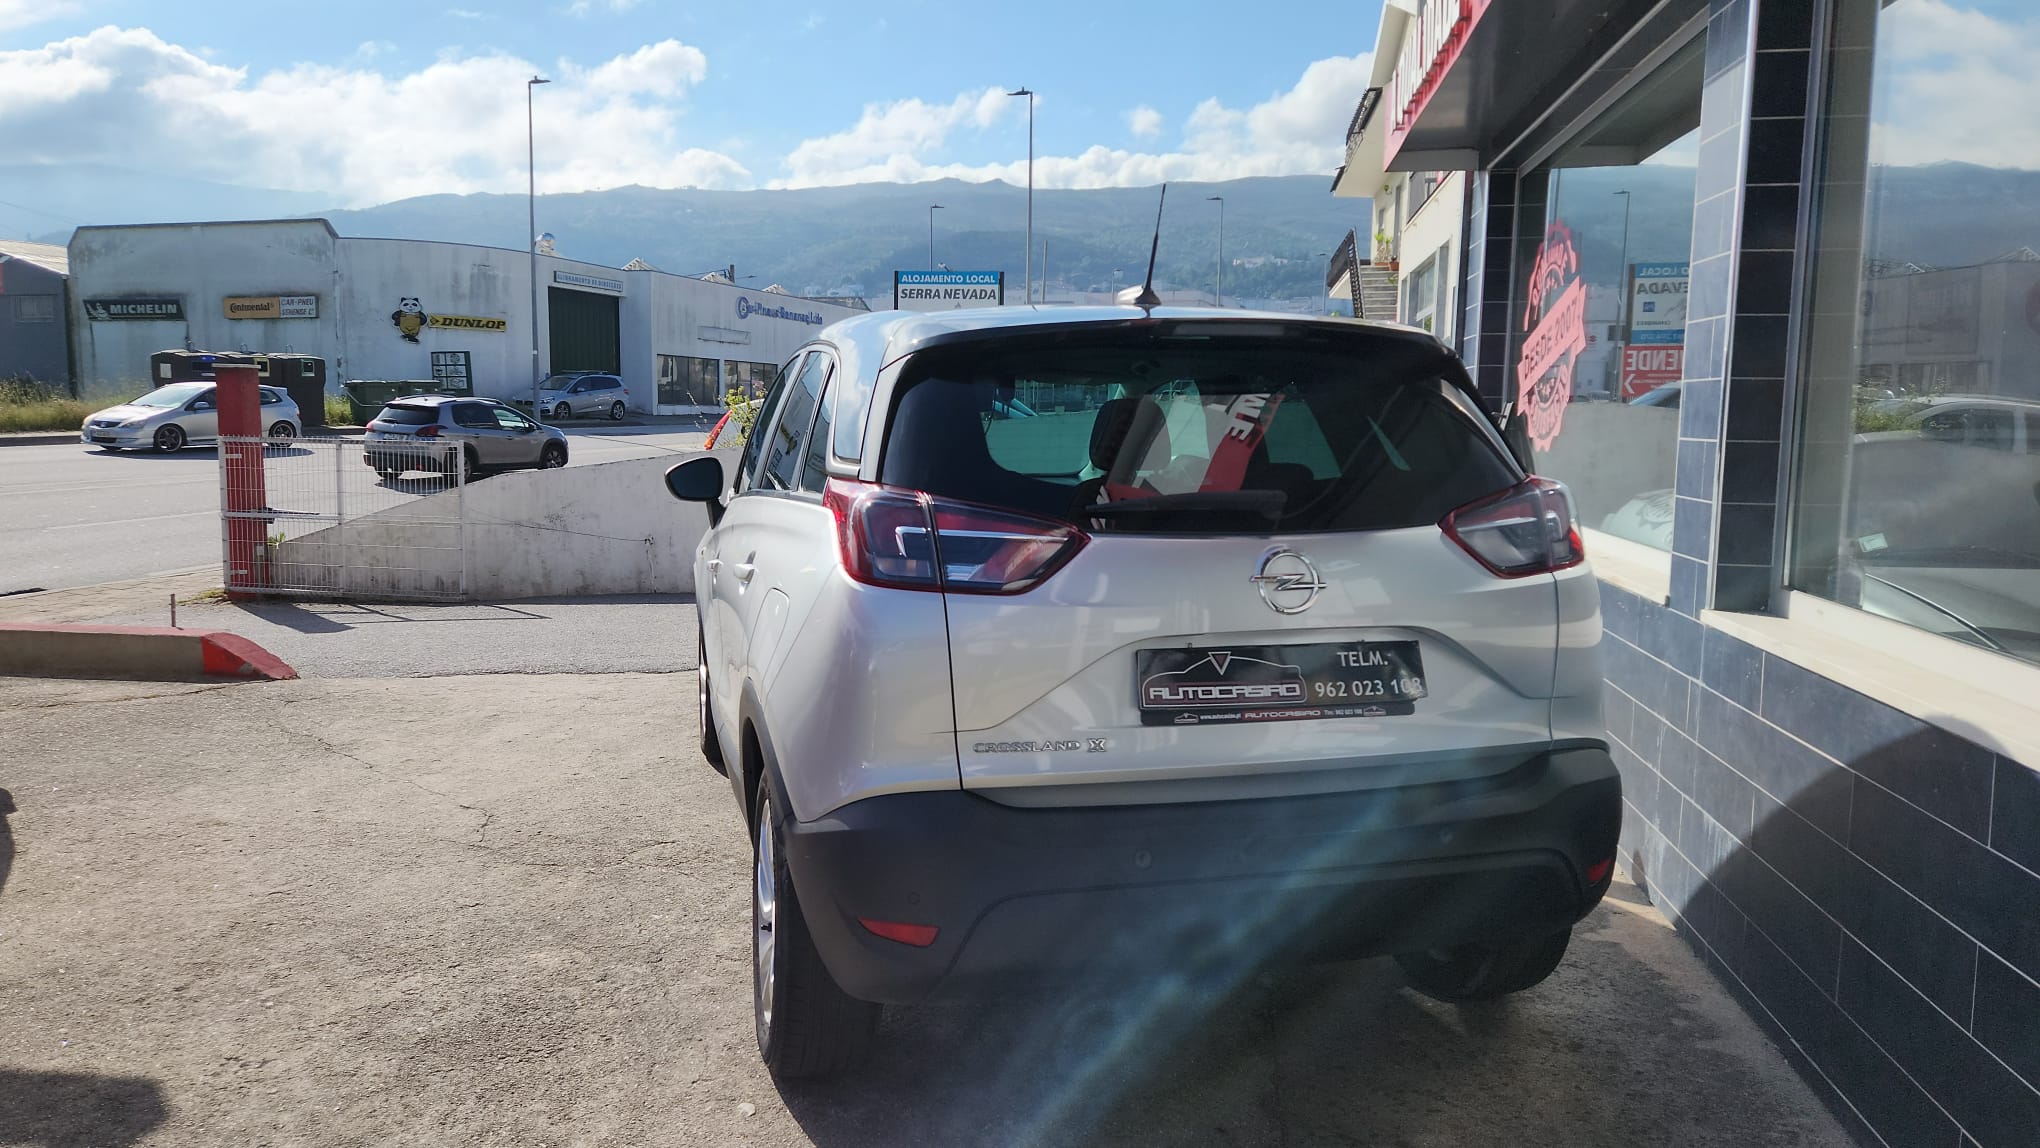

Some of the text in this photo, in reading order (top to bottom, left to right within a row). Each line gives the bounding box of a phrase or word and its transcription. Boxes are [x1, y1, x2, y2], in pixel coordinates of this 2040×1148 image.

[902, 274, 995, 283] ALOJAMENTO LOCAL
[901, 288, 996, 300] SERRA NEVADA
[110, 303, 177, 314] MICHELIN
[230, 302, 270, 312] Continental
[441, 316, 506, 329] DUNLOP
[1524, 330, 1551, 380] DESDE
[1555, 298, 1578, 348] 2007
[1336, 651, 1388, 667] TELM.
[1314, 681, 1347, 697] 962
[1352, 680, 1384, 696] 023
[973, 738, 1107, 752] CROSSLAND X
